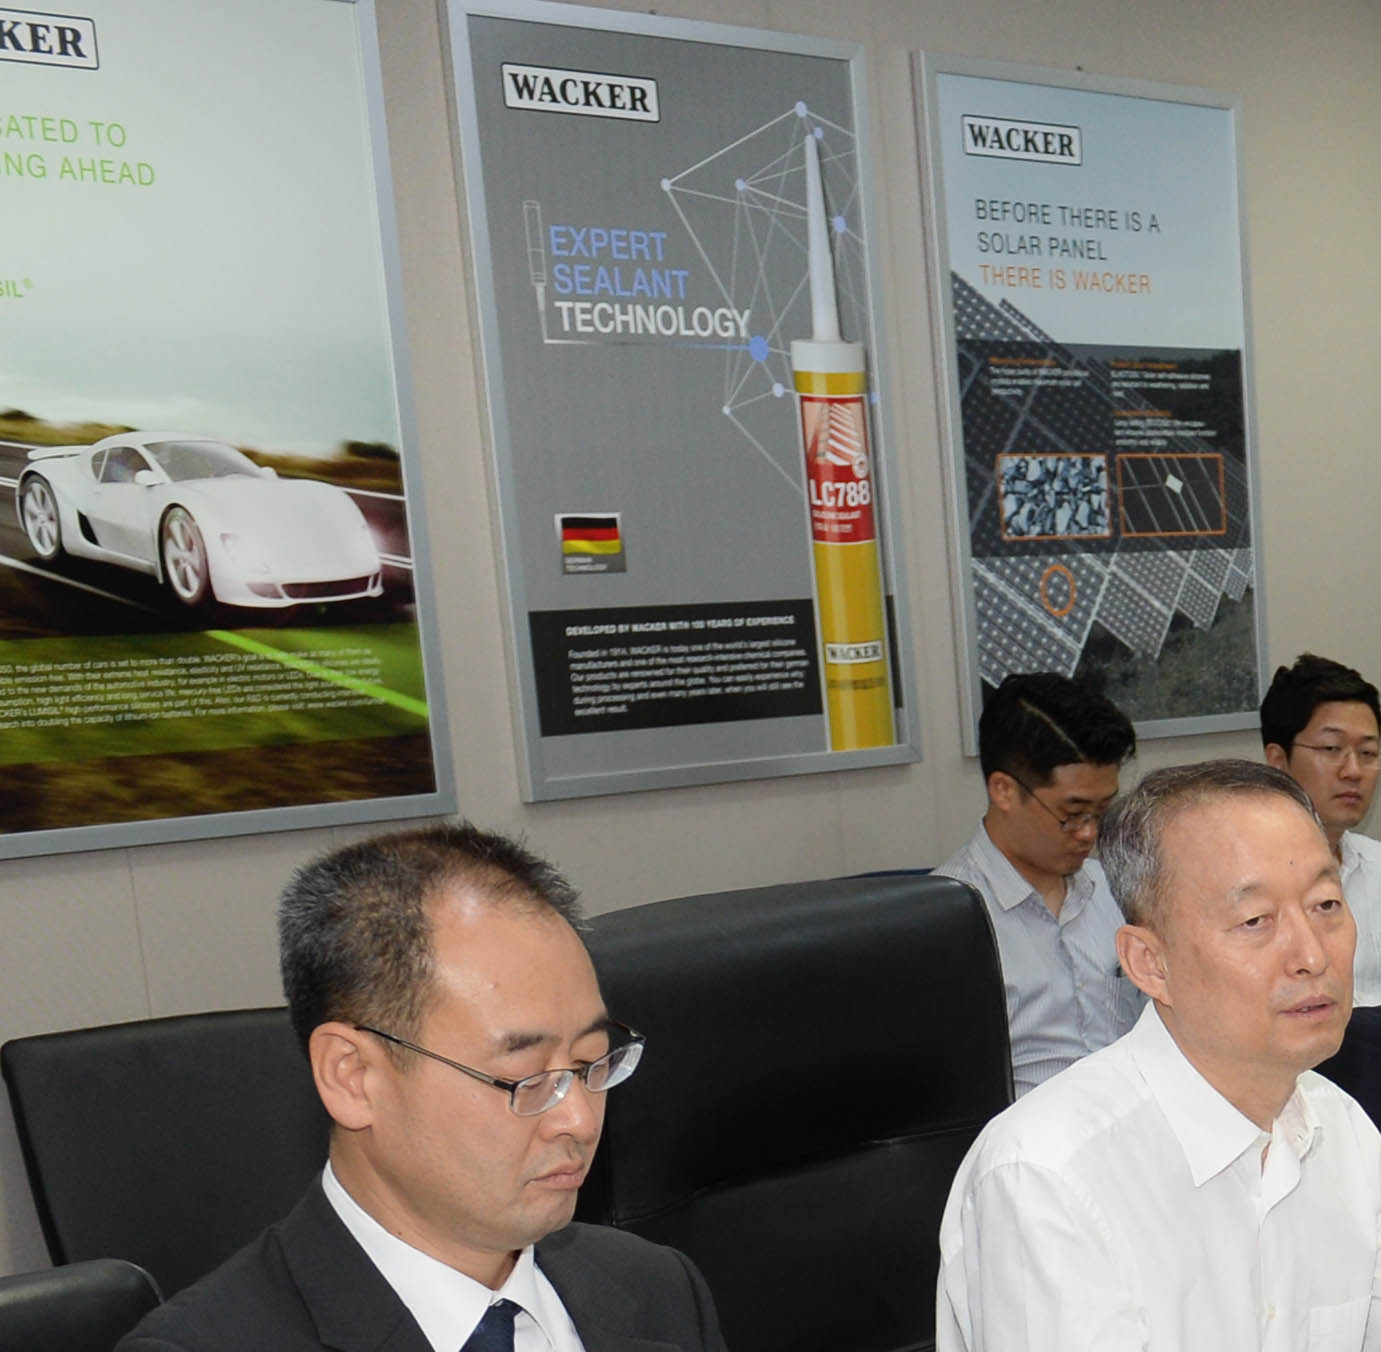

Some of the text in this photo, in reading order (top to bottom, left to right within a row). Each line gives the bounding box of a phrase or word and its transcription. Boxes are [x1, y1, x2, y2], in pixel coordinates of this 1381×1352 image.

[508, 73, 651, 113] WACKER
[0, 114, 126, 148] ATED TO
[967, 123, 1075, 157] WACKER
[0, 151, 156, 186] NG AHEAD
[975, 199, 1161, 233] BEFORE THERE IS A
[549, 224, 667, 261] EXPERT
[977, 232, 1108, 261] SOLAR PANEL
[552, 264, 689, 299] SEALANT
[979, 264, 1152, 294] THERE IS WACKER
[554, 301, 751, 338] TECHNOLOGY
[809, 478, 871, 508] LC788
